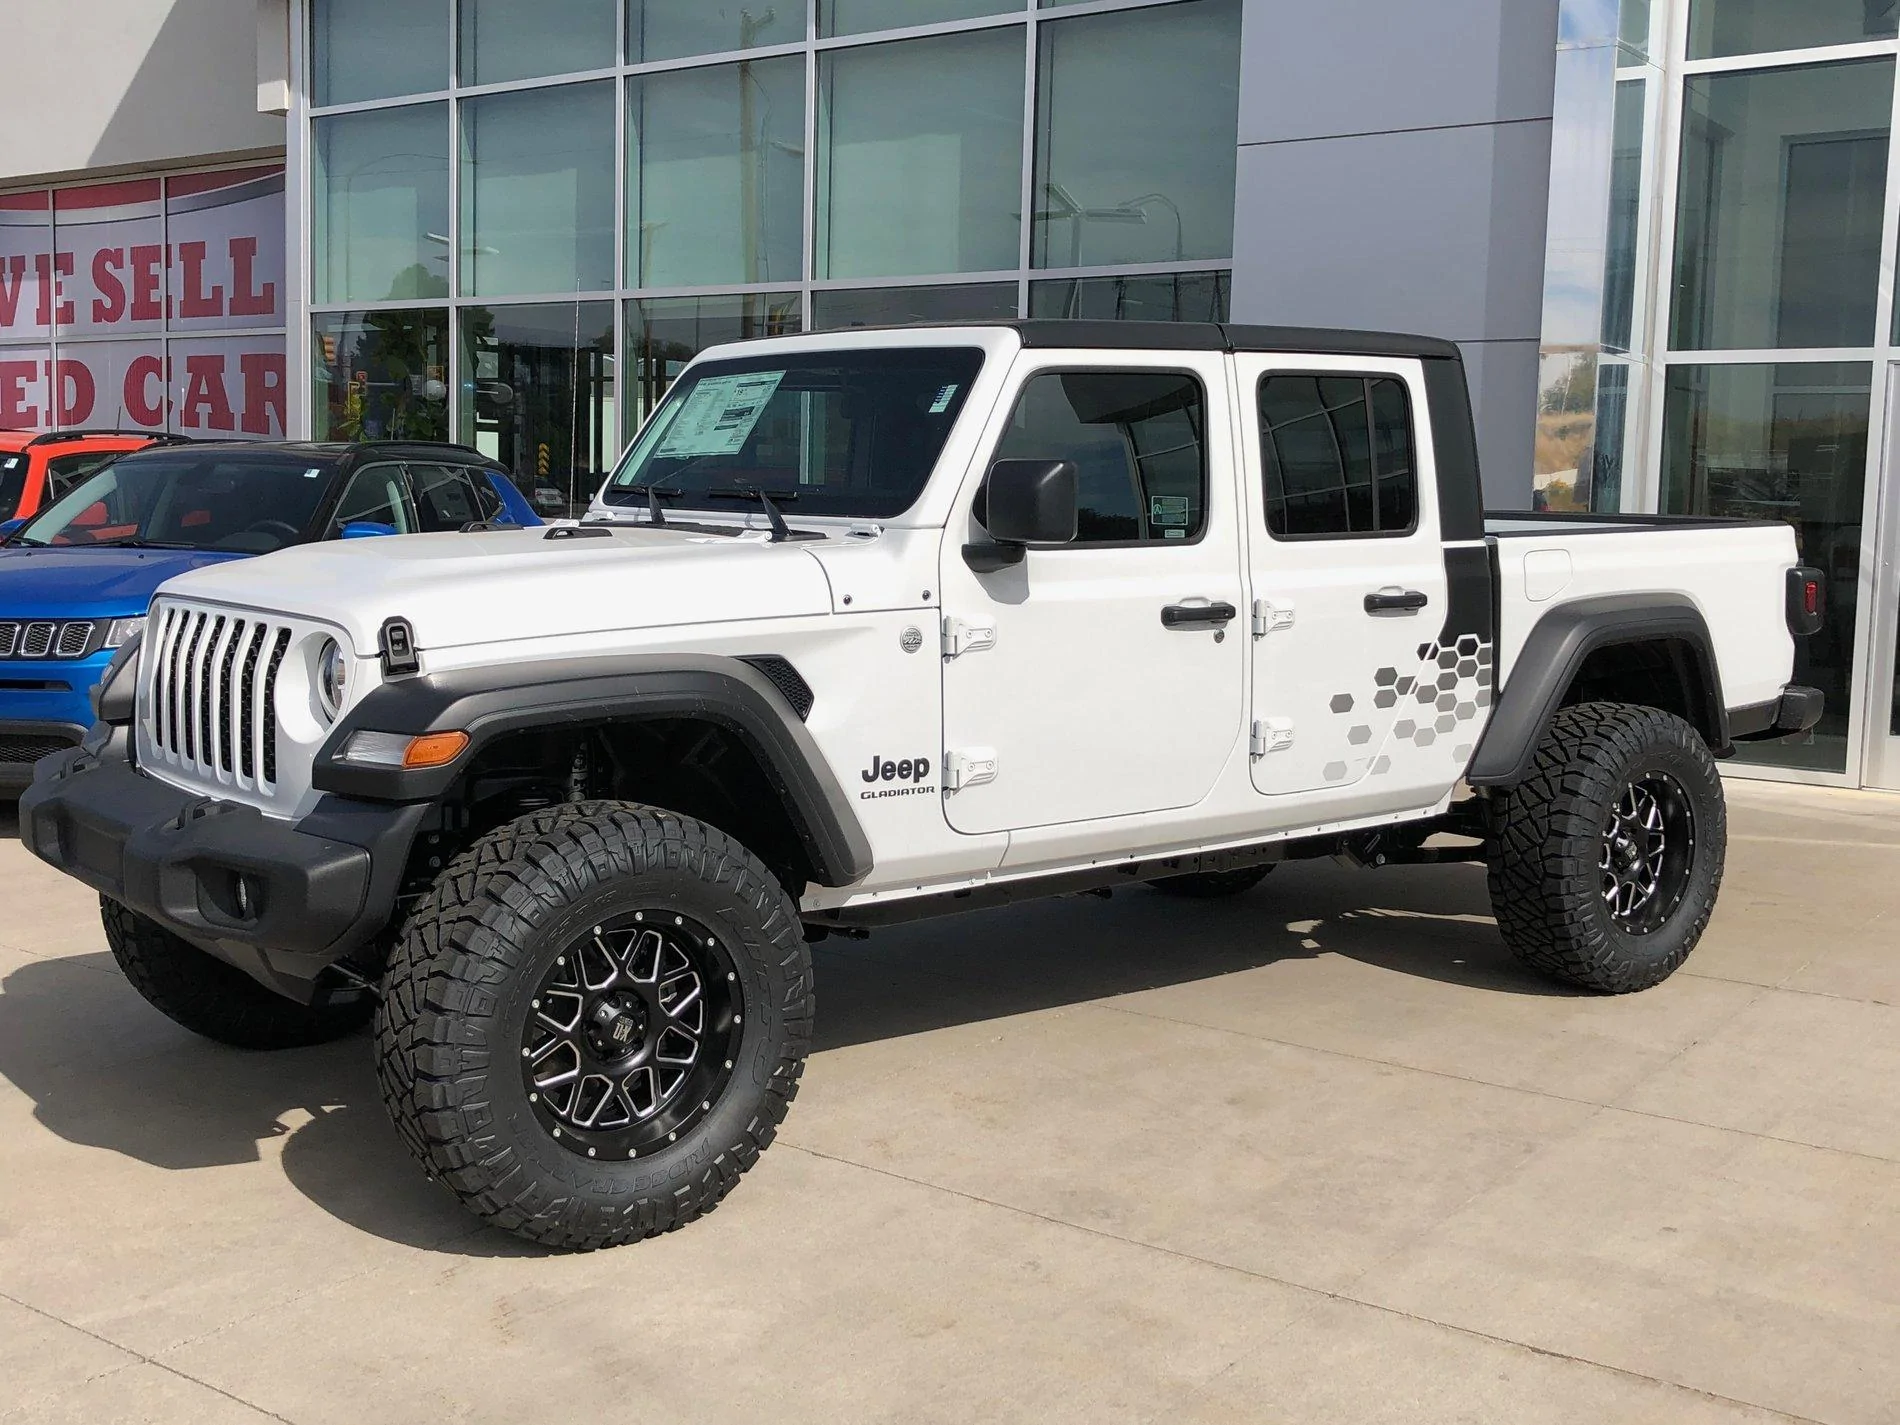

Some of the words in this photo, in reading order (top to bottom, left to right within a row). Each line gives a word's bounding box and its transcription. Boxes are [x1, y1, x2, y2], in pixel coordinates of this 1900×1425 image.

[91, 236, 275, 323] SELL
[124, 353, 286, 437] CAR
[860, 786, 935, 800] GLADIATOR
[861, 755, 930, 783] Jeep
